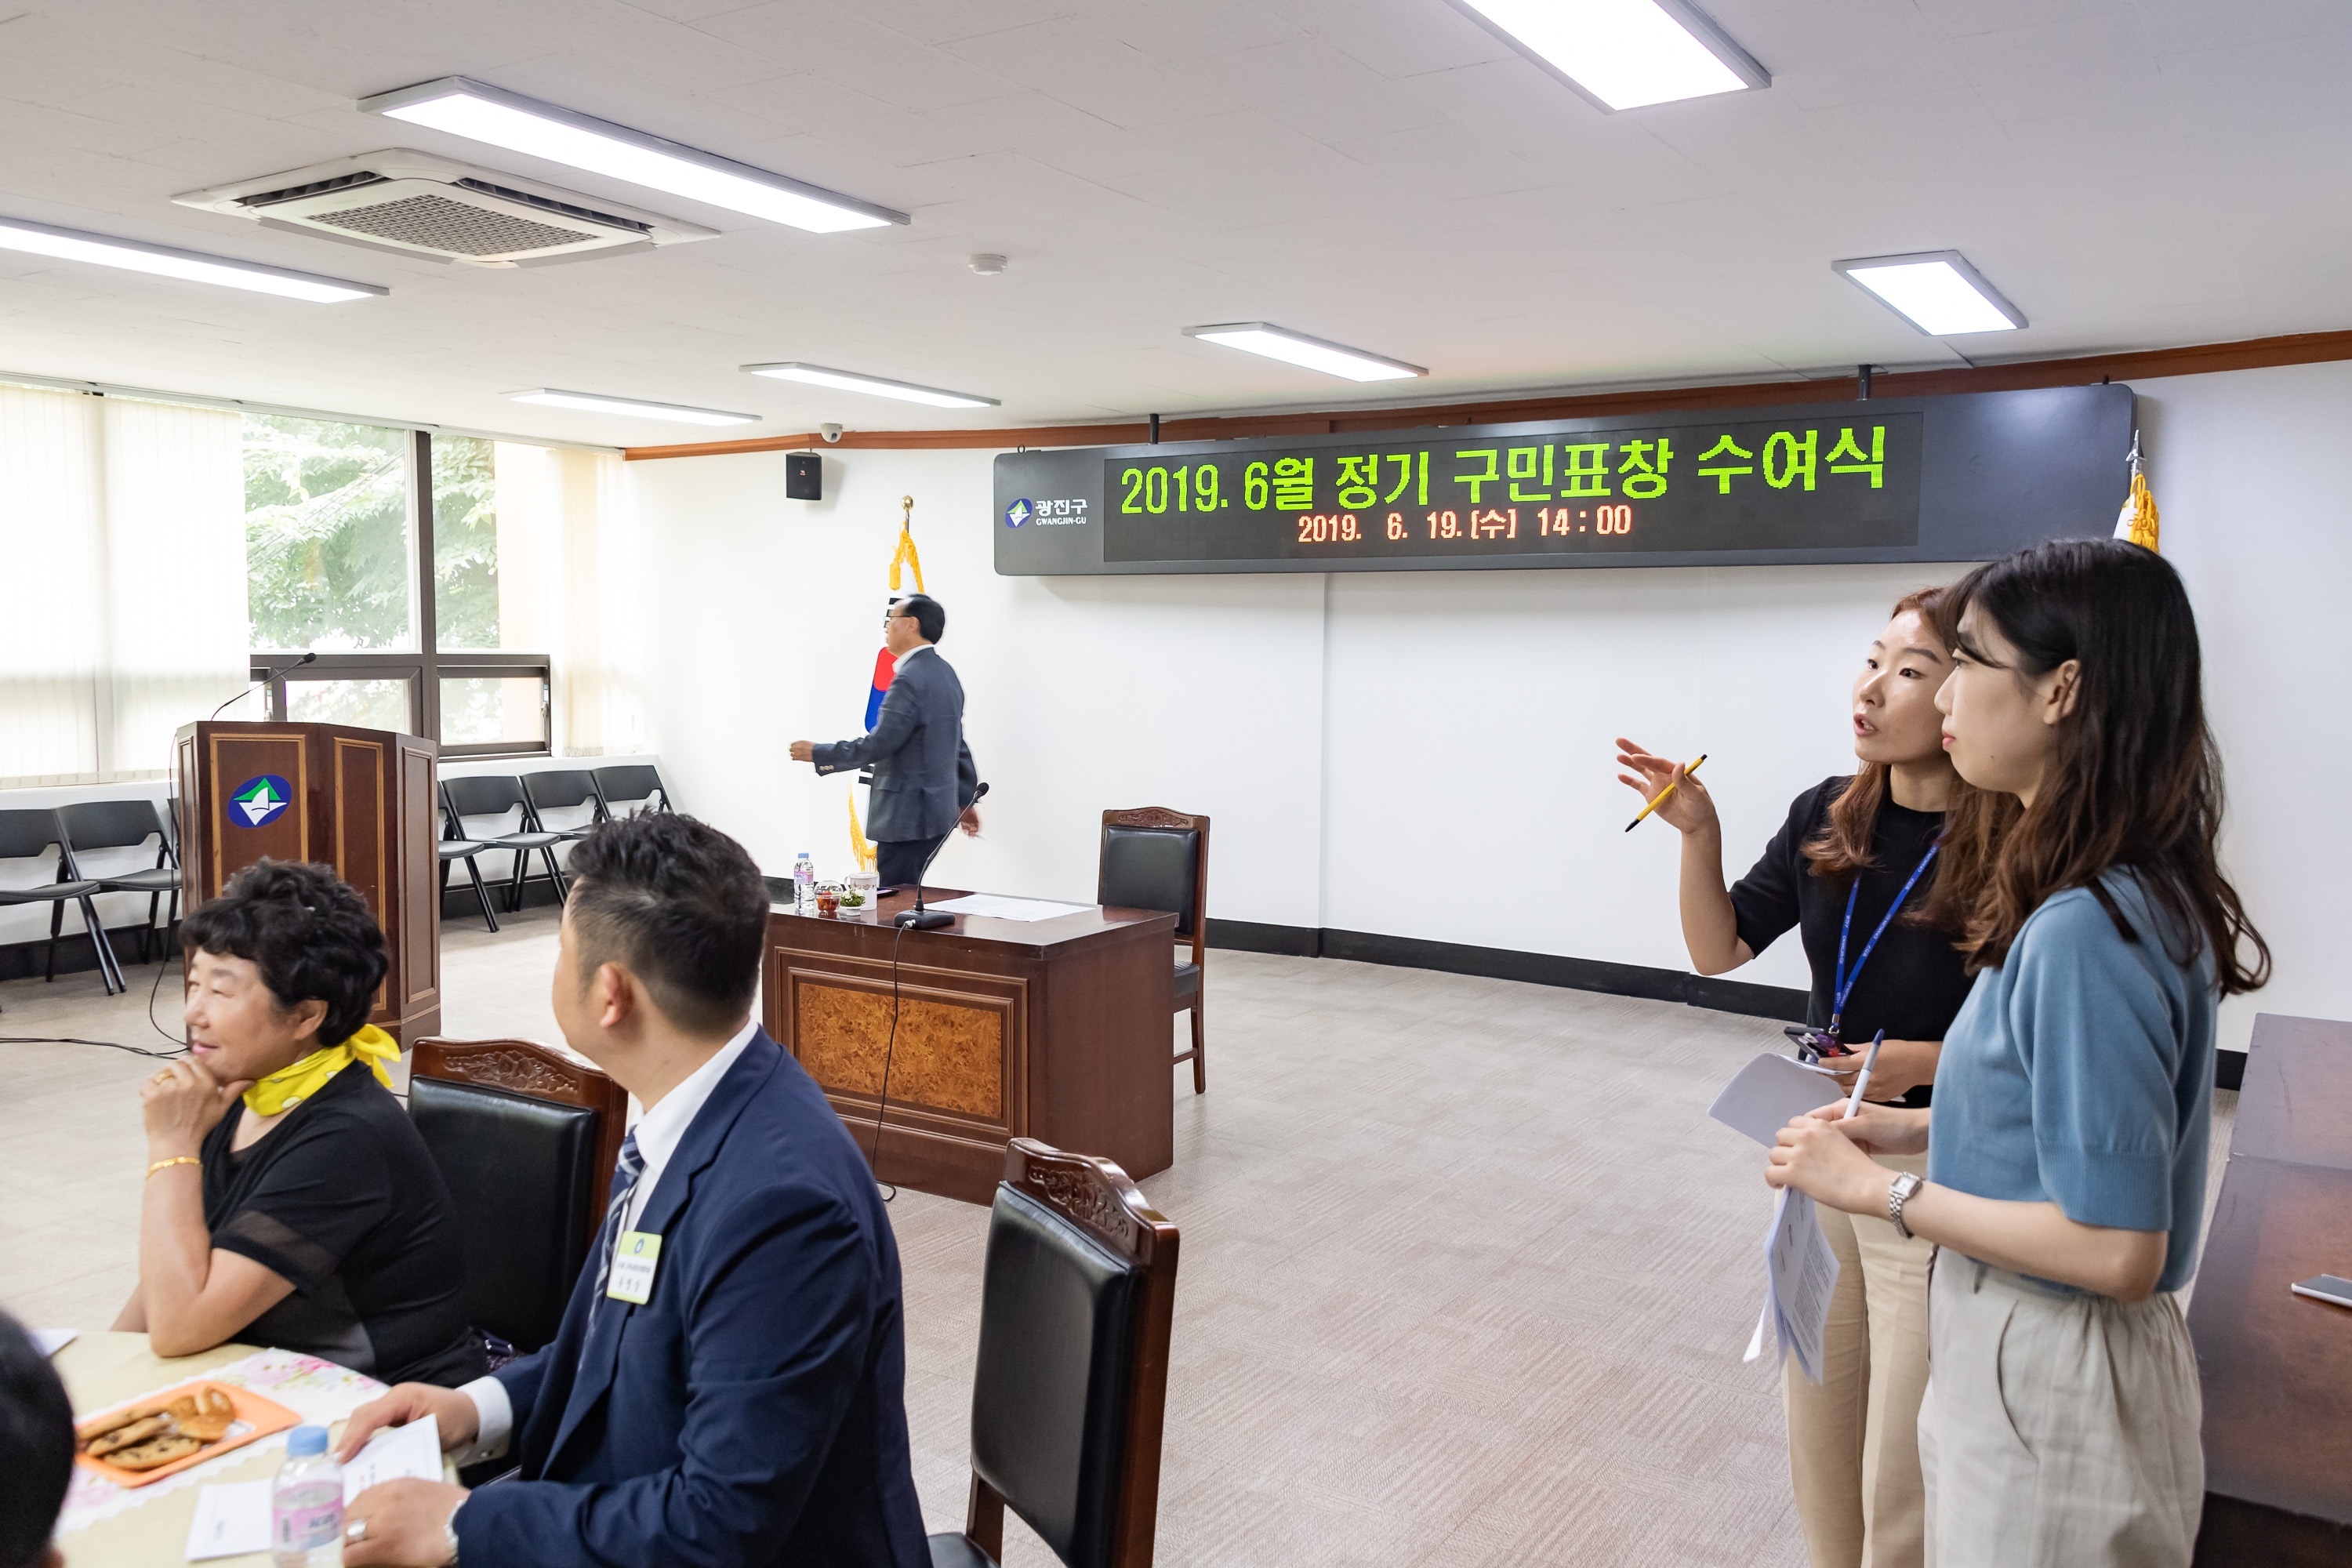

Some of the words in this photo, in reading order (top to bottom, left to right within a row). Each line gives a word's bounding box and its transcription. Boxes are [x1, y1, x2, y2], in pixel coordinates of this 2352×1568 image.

[1121, 464, 1228, 514] 2019.
[1244, 456, 1314, 511] 6월
[1335, 451, 1429, 510] 정기
[1454, 437, 1675, 504] 구민표창
[1697, 426, 1886, 495] 수여식
[1035, 499, 1088, 517] 광진구
[1035, 517, 1087, 526] GWANGJIN-GU
[1298, 514, 1362, 543] 2019.
[1386, 512, 1408, 540] 6.
